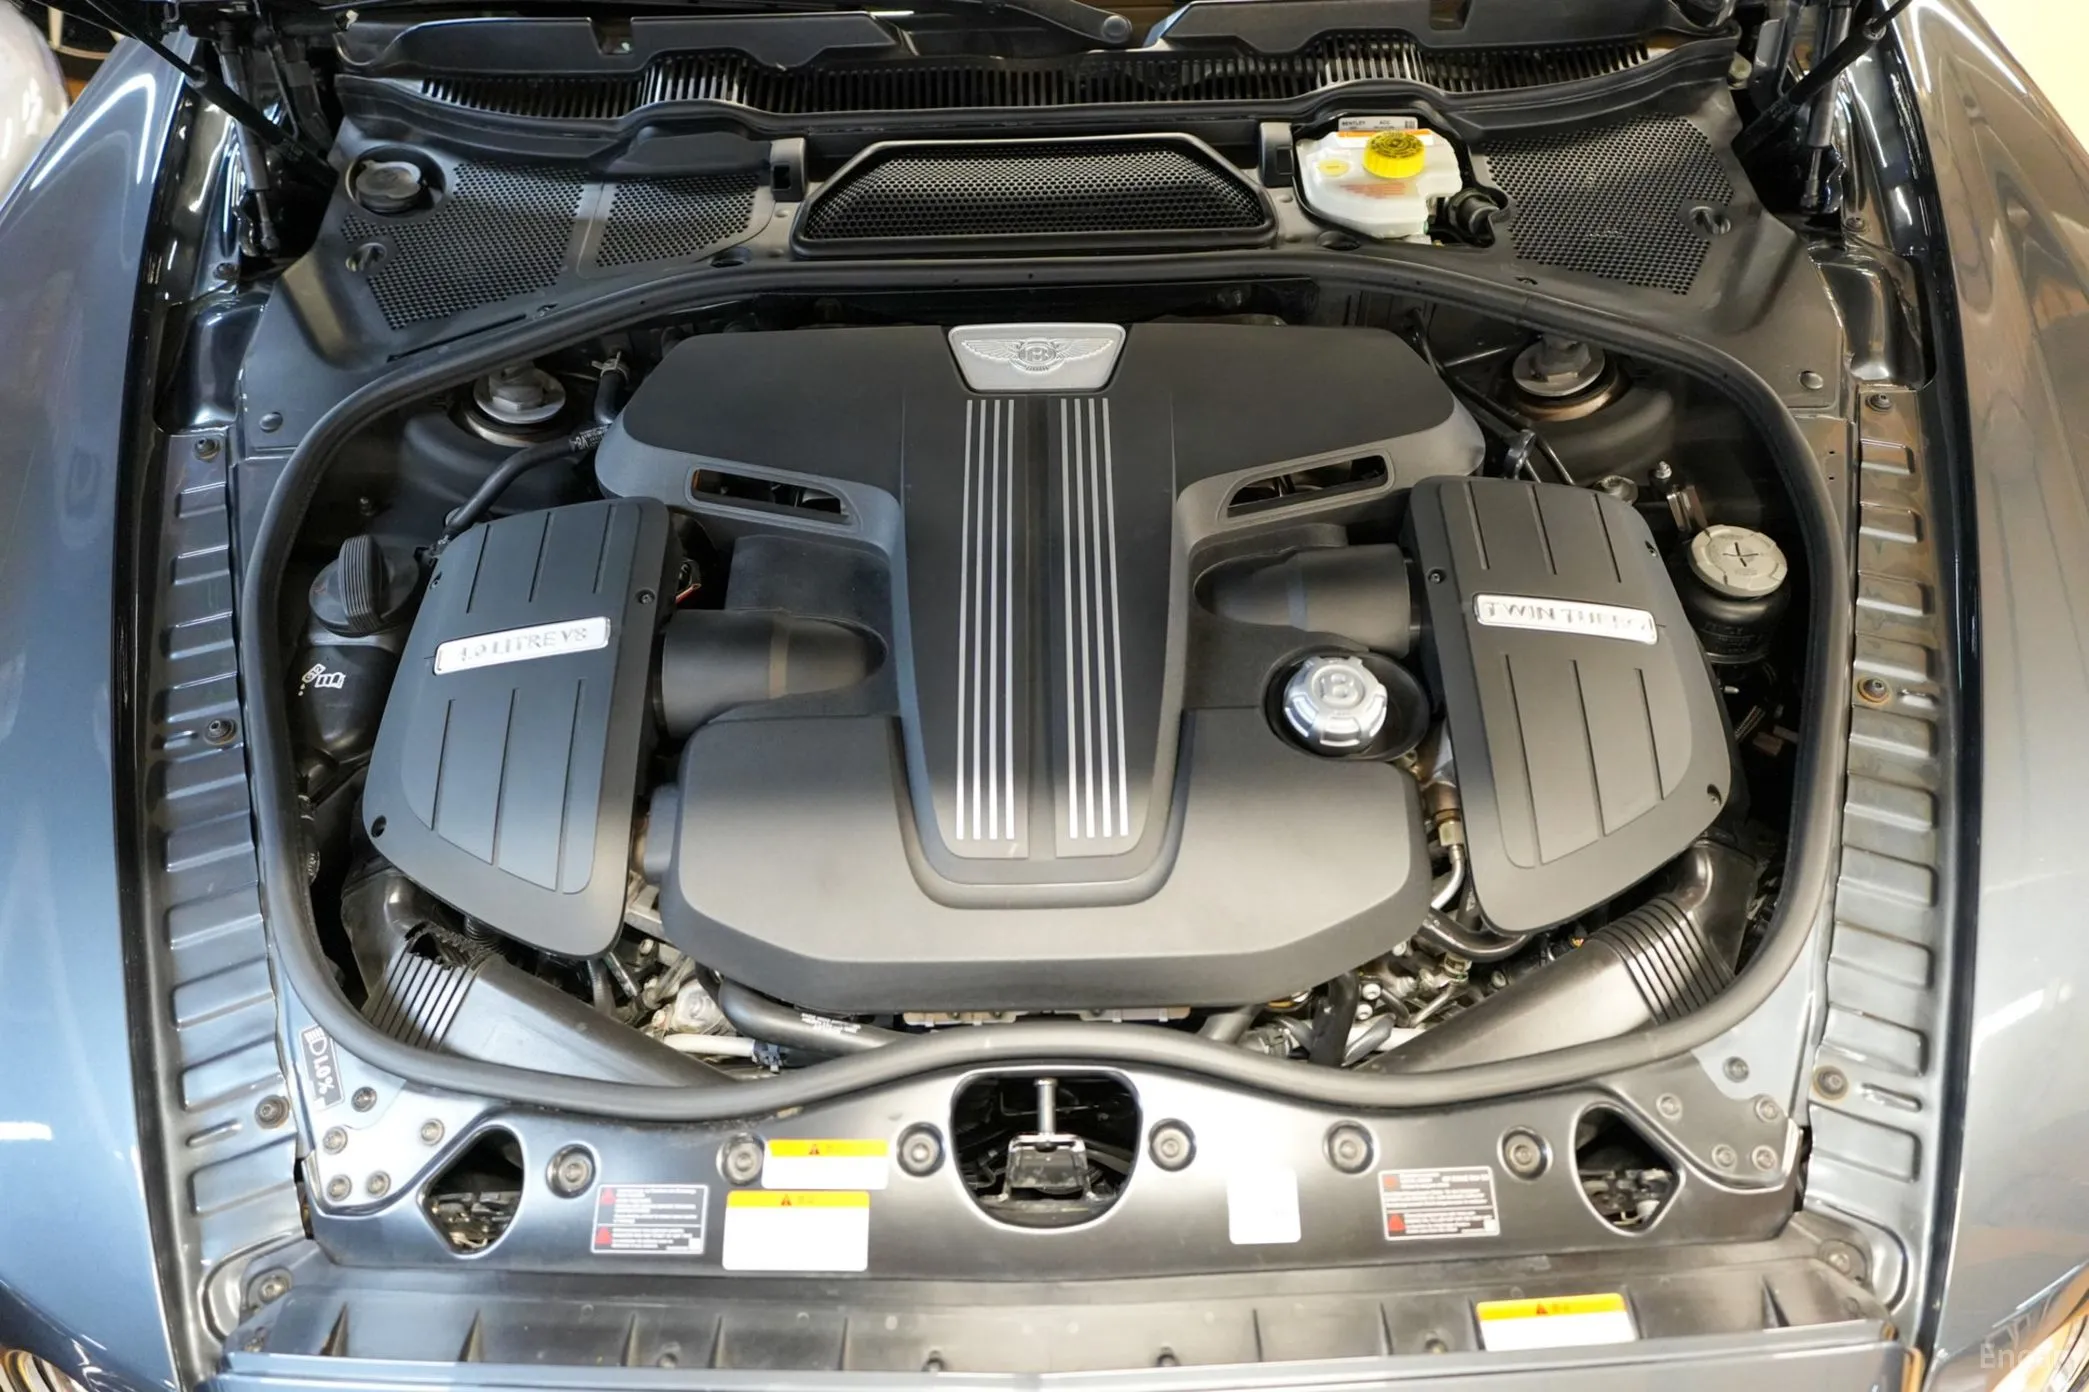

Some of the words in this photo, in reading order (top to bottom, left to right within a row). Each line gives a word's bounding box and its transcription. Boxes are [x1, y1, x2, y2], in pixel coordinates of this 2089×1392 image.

[1483, 601, 1557, 620] TWIN
[492, 630, 557, 654] LITRE
[561, 627, 588, 643] V8
